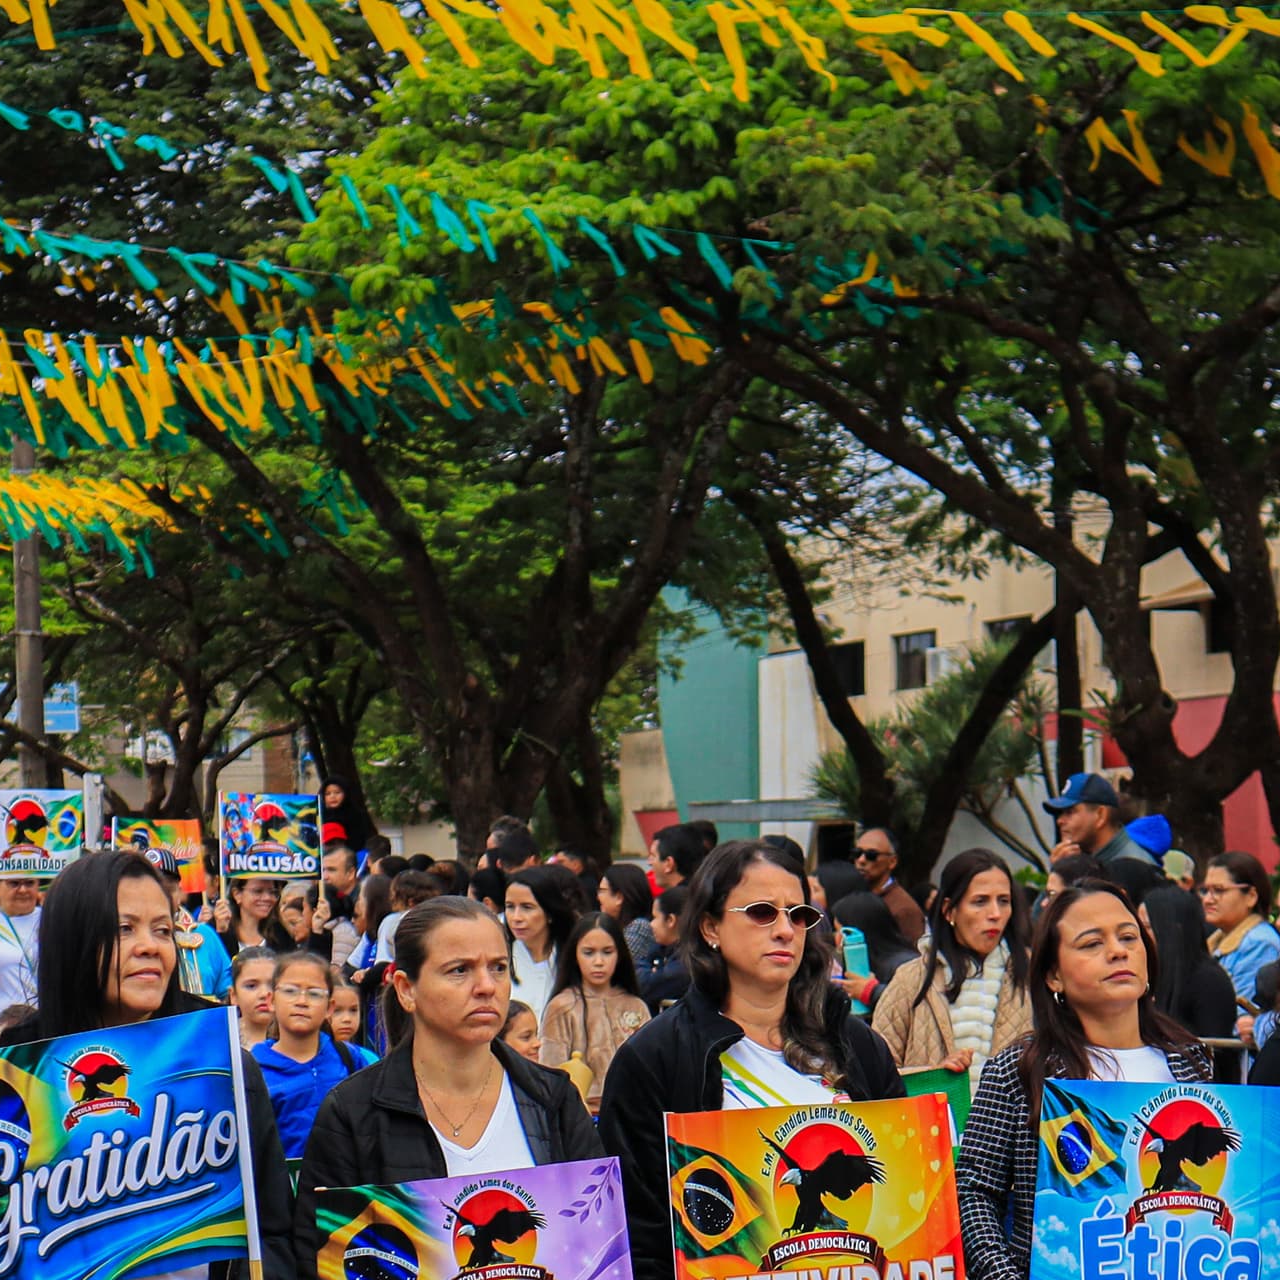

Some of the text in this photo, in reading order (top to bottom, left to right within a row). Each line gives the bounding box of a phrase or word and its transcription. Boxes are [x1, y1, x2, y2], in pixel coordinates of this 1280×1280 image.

[229, 852, 316, 872] INCLUSÃO
[1179, 1085, 1202, 1097] Lemes
[1202, 1090, 1215, 1103] dos
[762, 1152, 776, 1177] E.M.
[809, 1106, 837, 1120] Lemes
[839, 1110, 854, 1127] dos
[854, 1118, 877, 1151] Santos
[479, 1179, 500, 1189] Lemes
[502, 1179, 514, 1190] dos
[515, 1185, 537, 1209] Santos
[1140, 1194, 1220, 1212] ESCOLA DEMOCRÁTICA
[773, 1234, 871, 1262] ESCOLA DEMOCRÁTICA
[486, 1266, 541, 1279] DEMOCRÁTICA
